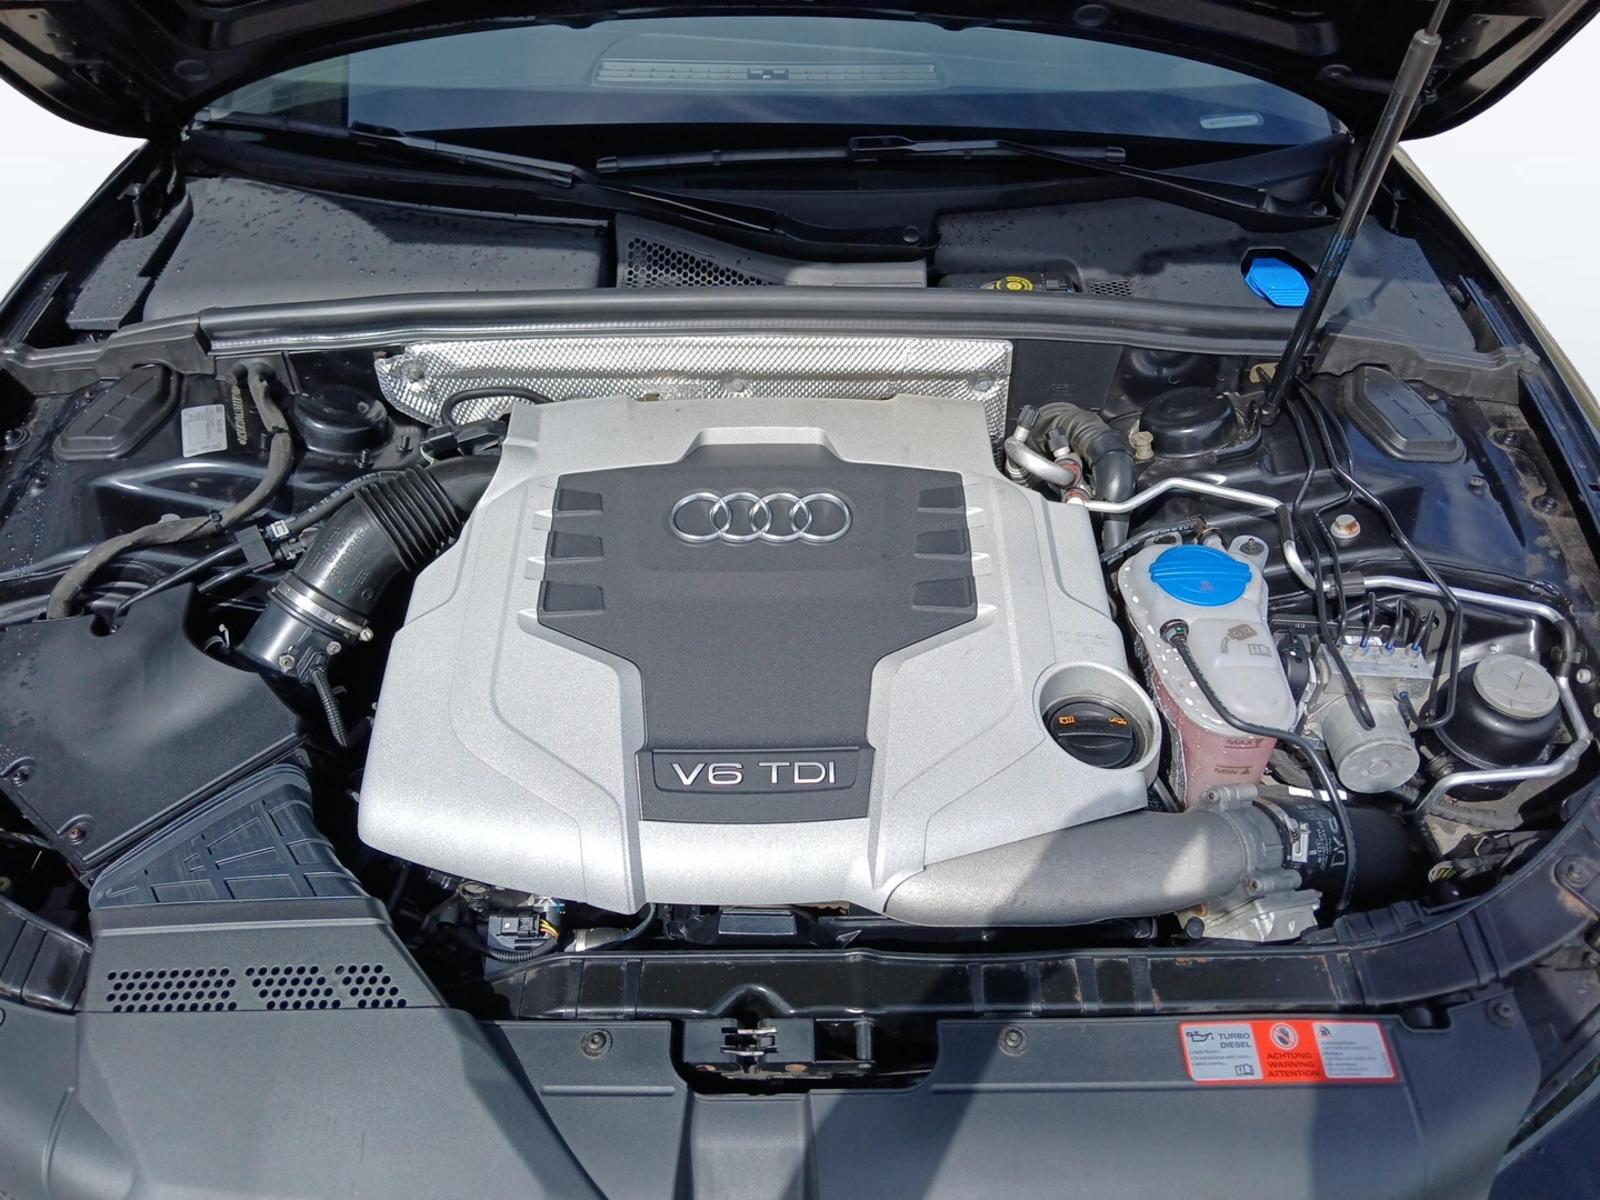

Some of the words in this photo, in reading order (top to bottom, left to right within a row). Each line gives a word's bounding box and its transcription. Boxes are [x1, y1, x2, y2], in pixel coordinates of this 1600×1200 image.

[671, 762, 744, 786] V6
[758, 761, 836, 784] TDI
[1214, 767, 1239, 775] MIN
[1217, 1032, 1251, 1040] TURBO
[1220, 1041, 1252, 1049] DIESEL
[1267, 1052, 1313, 1060] ACHTUNG
